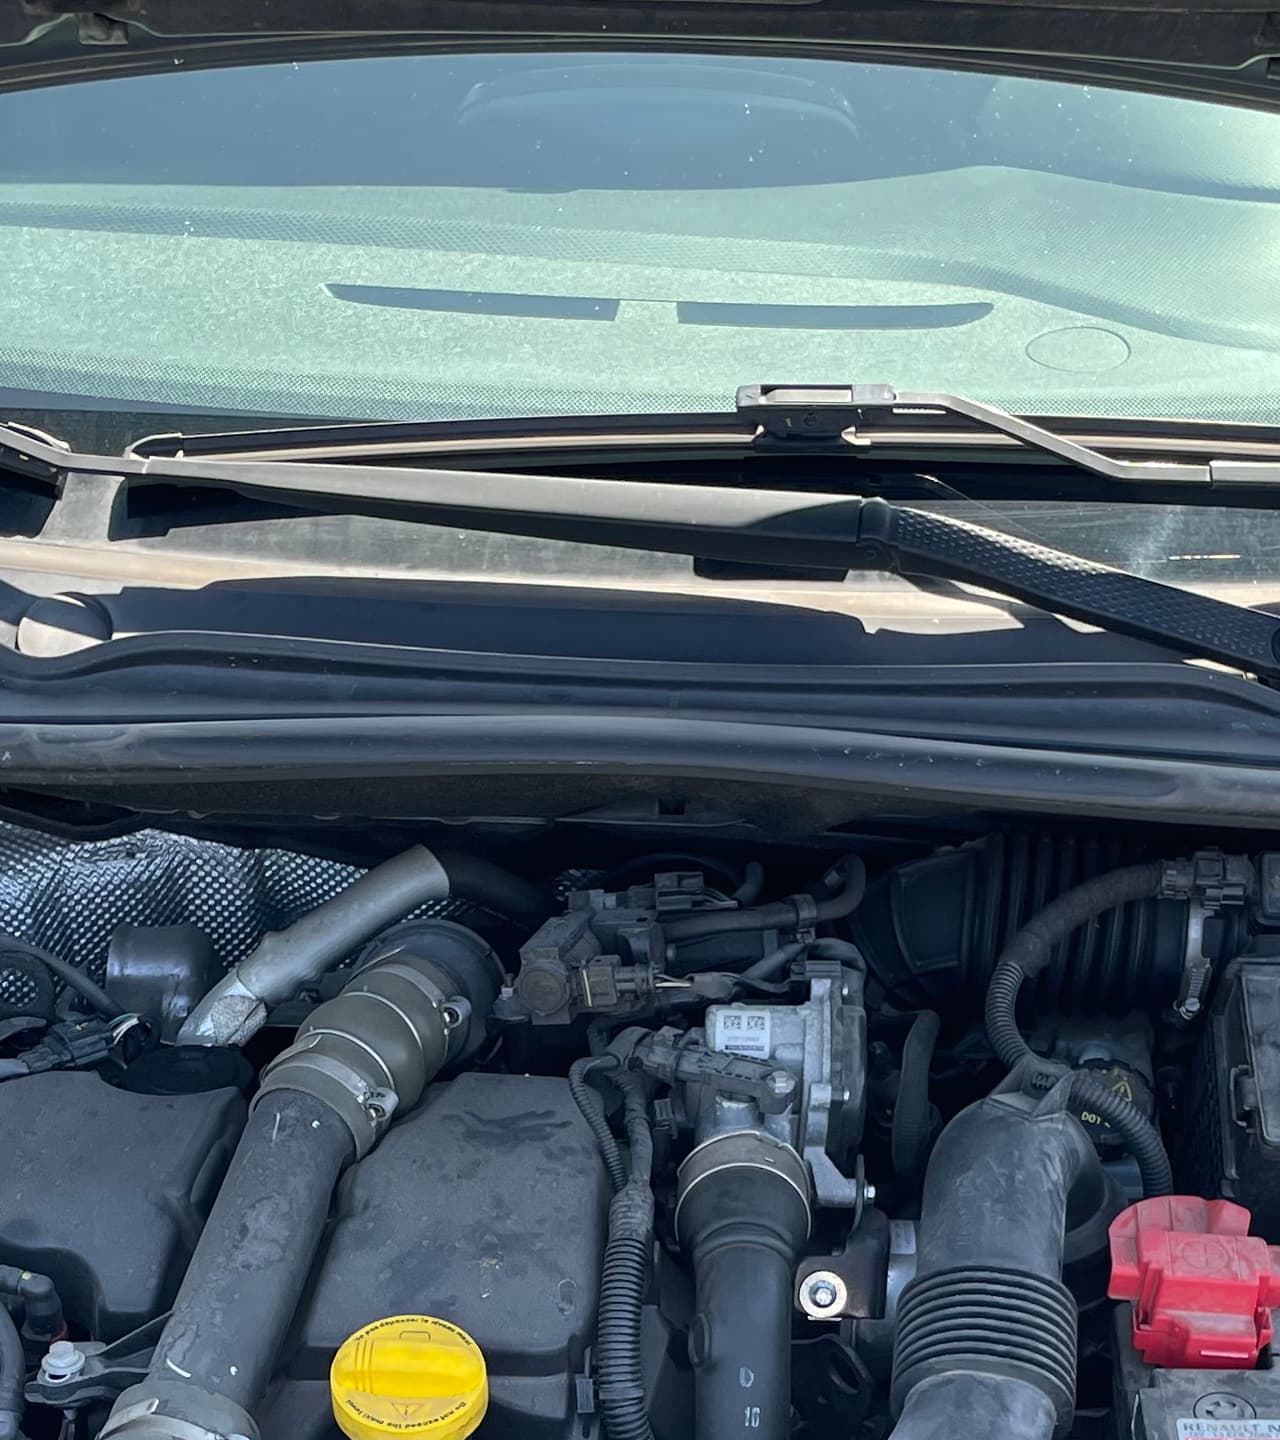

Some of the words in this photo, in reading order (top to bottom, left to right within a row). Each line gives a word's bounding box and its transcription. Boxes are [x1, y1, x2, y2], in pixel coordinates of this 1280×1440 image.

[1081, 1111, 1101, 1125] DOT
[440, 1410, 455, 1421] not
[387, 1422, 402, 1430] the
[405, 1416, 440, 1429] exceed
[1183, 1423, 1259, 1433] RENAULT
